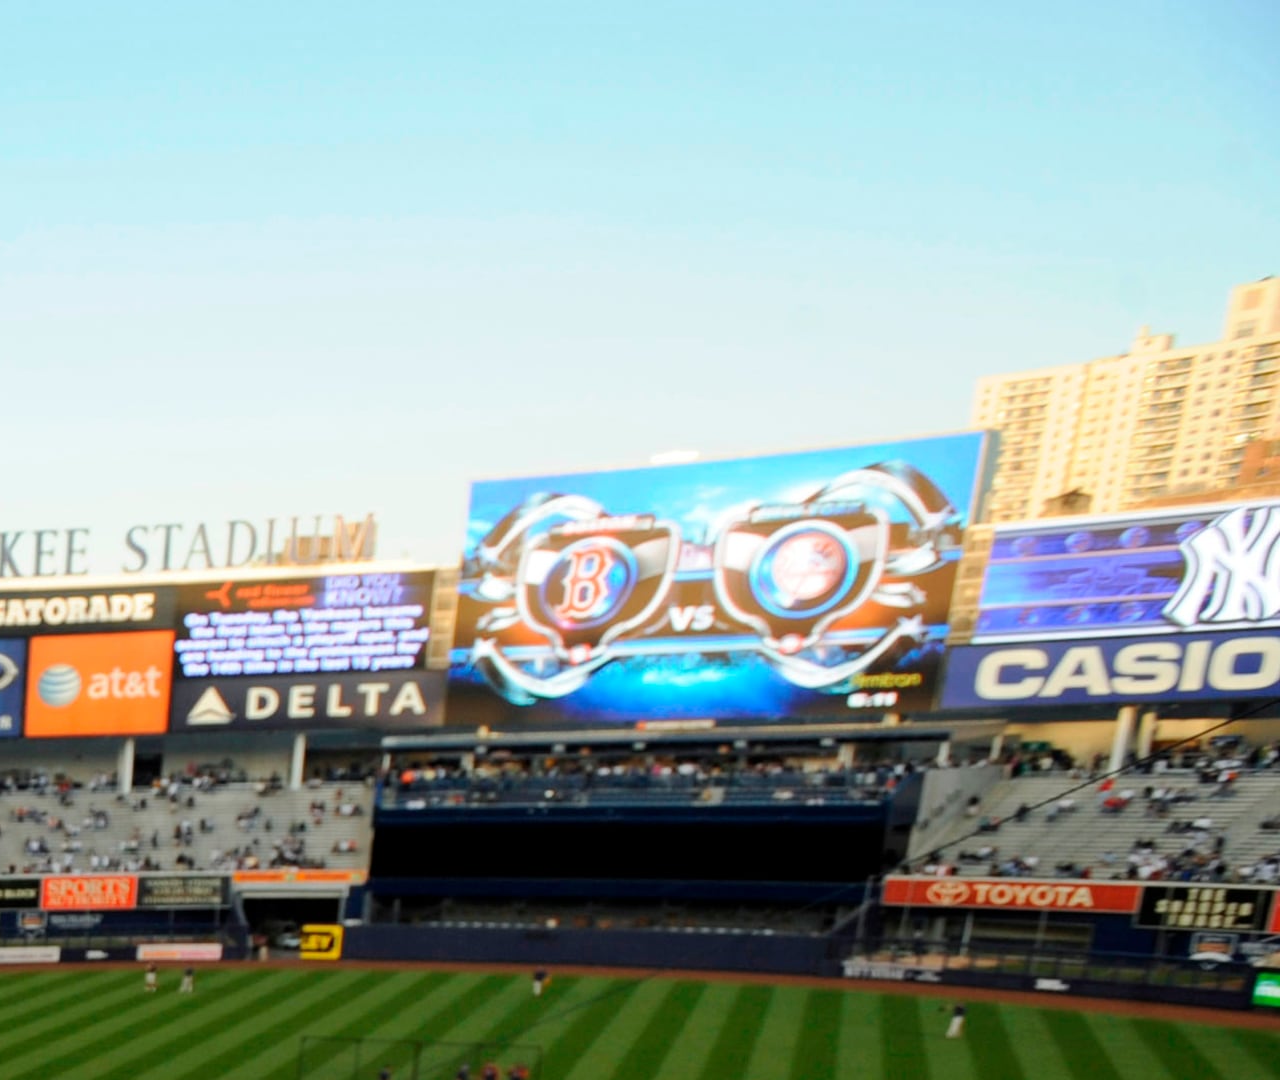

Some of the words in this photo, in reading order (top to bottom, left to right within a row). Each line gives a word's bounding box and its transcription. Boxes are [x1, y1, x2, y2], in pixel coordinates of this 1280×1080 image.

[122, 513, 377, 573] STADIUM
[87, 666, 162, 699] at&t
[973, 636, 1280, 701] CASIO
[245, 681, 427, 720] DELTA
[46, 877, 131, 898] SPORTS
[973, 884, 1094, 908] TOYOTA
